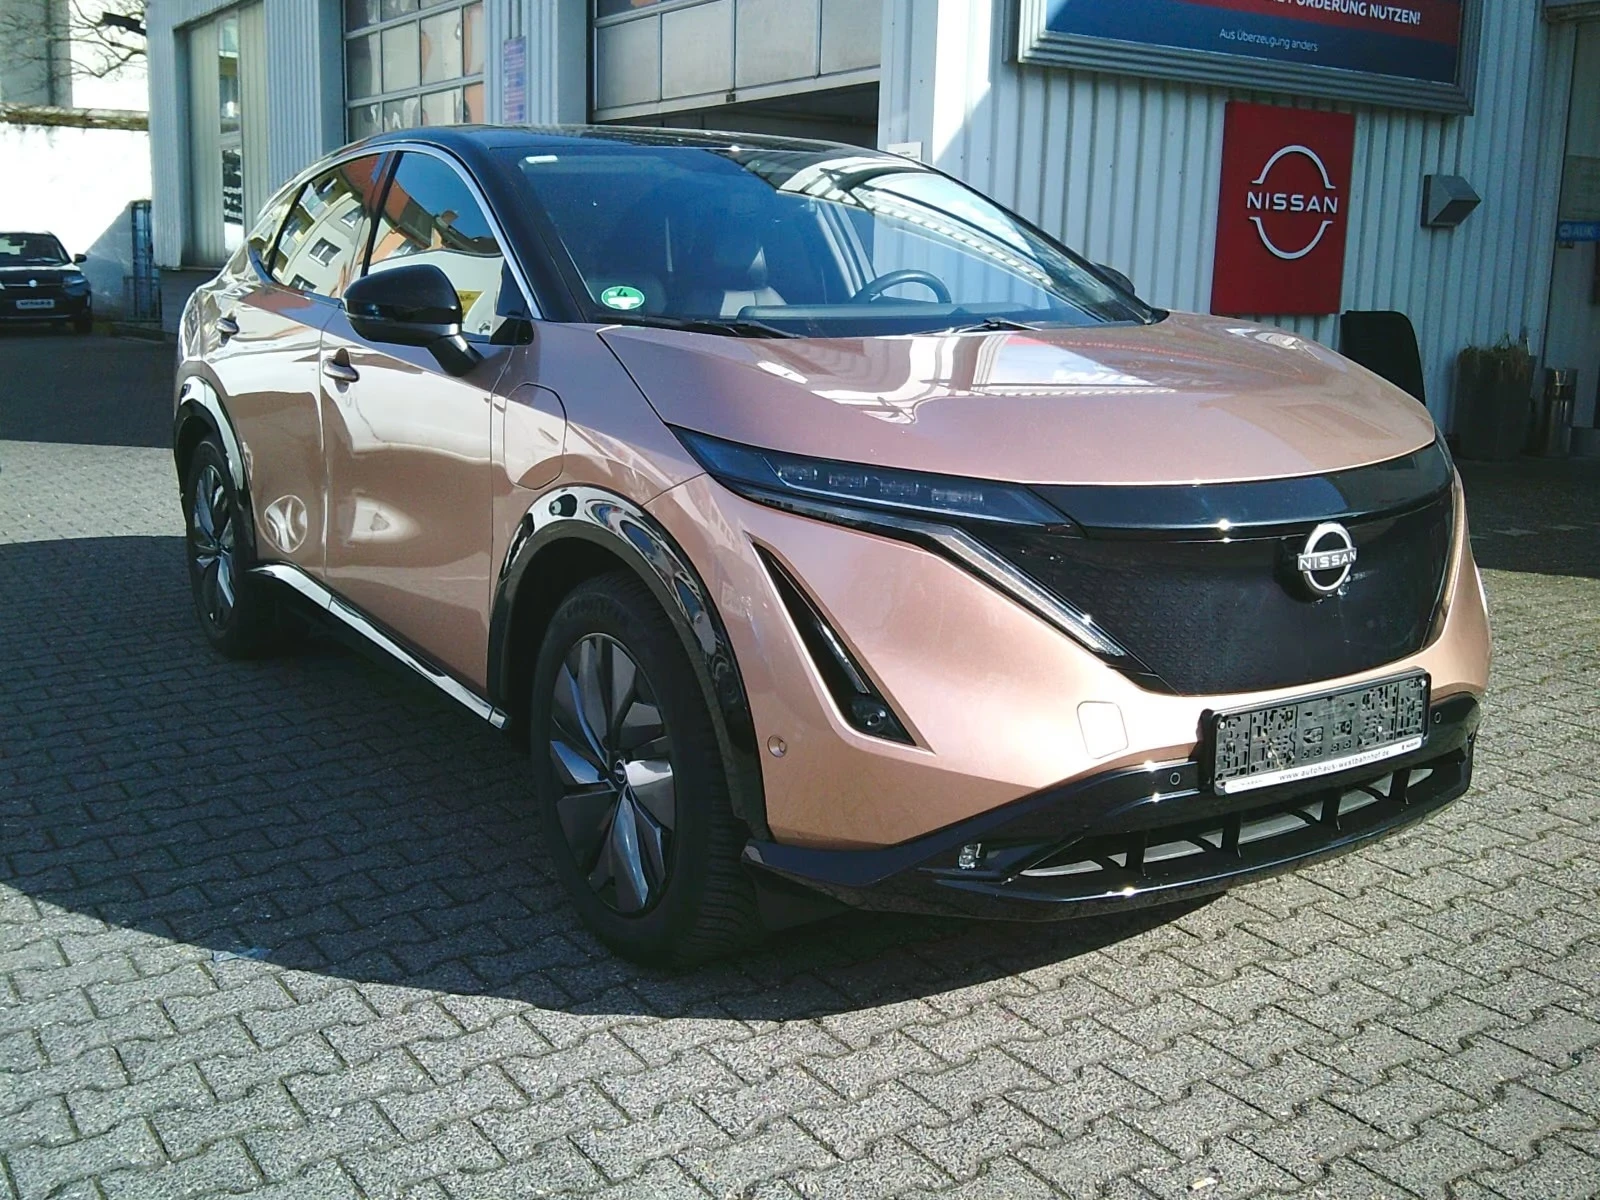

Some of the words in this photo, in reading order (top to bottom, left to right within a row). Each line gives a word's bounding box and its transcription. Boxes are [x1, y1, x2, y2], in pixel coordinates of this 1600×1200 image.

[1369, 3, 1421, 25] NUTZEN!
[1219, 28, 1236, 40] Aus
[1236, 29, 1291, 50] Überzeugung
[1291, 39, 1319, 52] anders
[1246, 191, 1338, 214] NISSAN
[617, 288, 628, 297] 4
[1299, 550, 1357, 570] NISSAN
